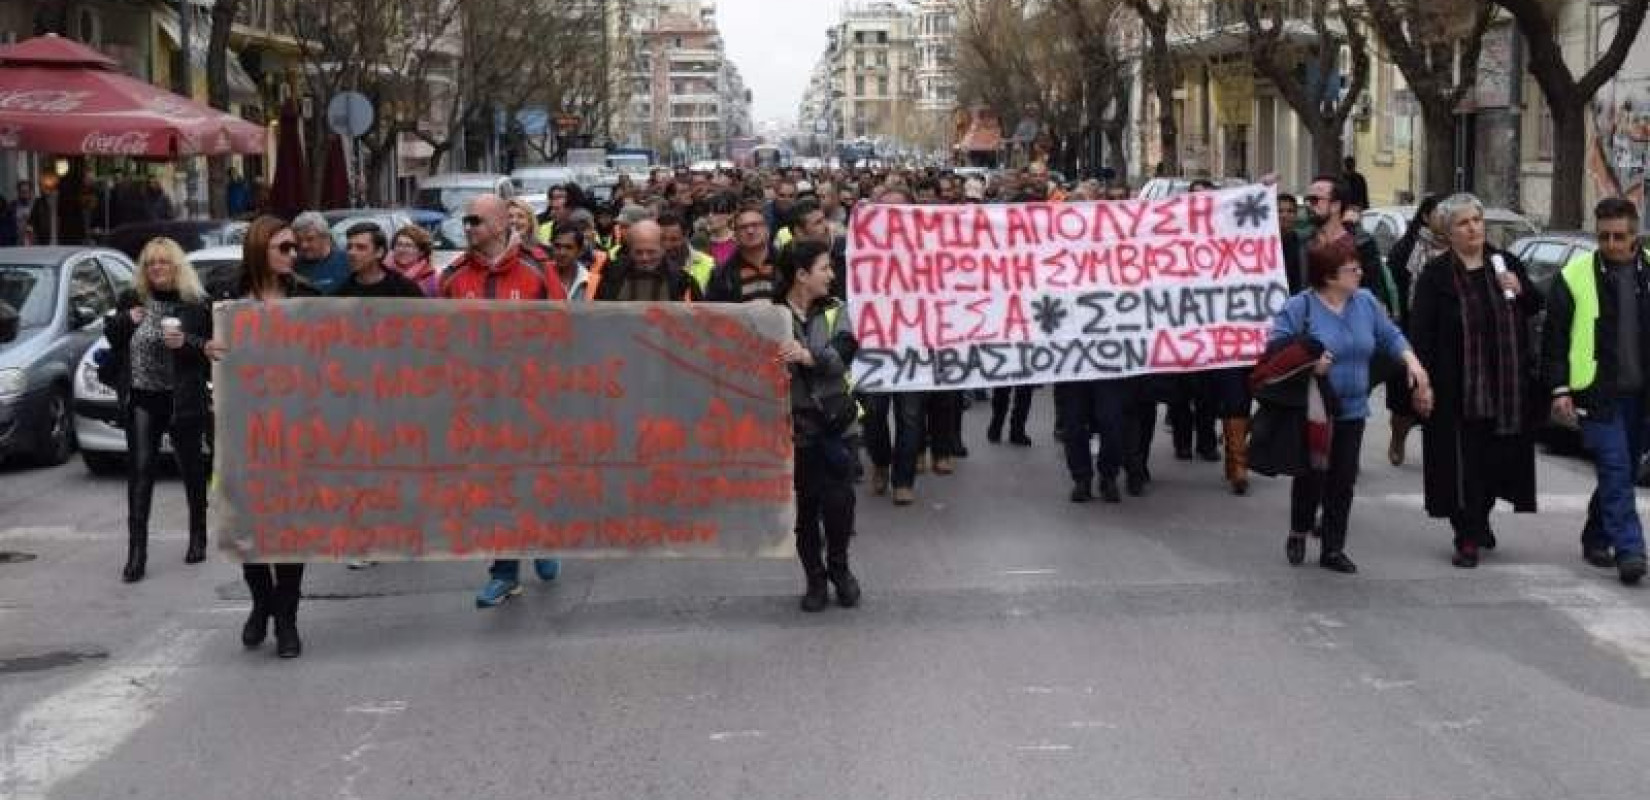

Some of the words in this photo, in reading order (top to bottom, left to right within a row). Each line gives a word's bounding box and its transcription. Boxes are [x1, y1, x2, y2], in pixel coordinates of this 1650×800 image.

[853, 203, 999, 250] ΚΑΜΙΑ
[1006, 196, 1213, 246] ΑΠΟΛΥΣΗ
[857, 294, 1029, 348] ΑΜΕΣΑ
